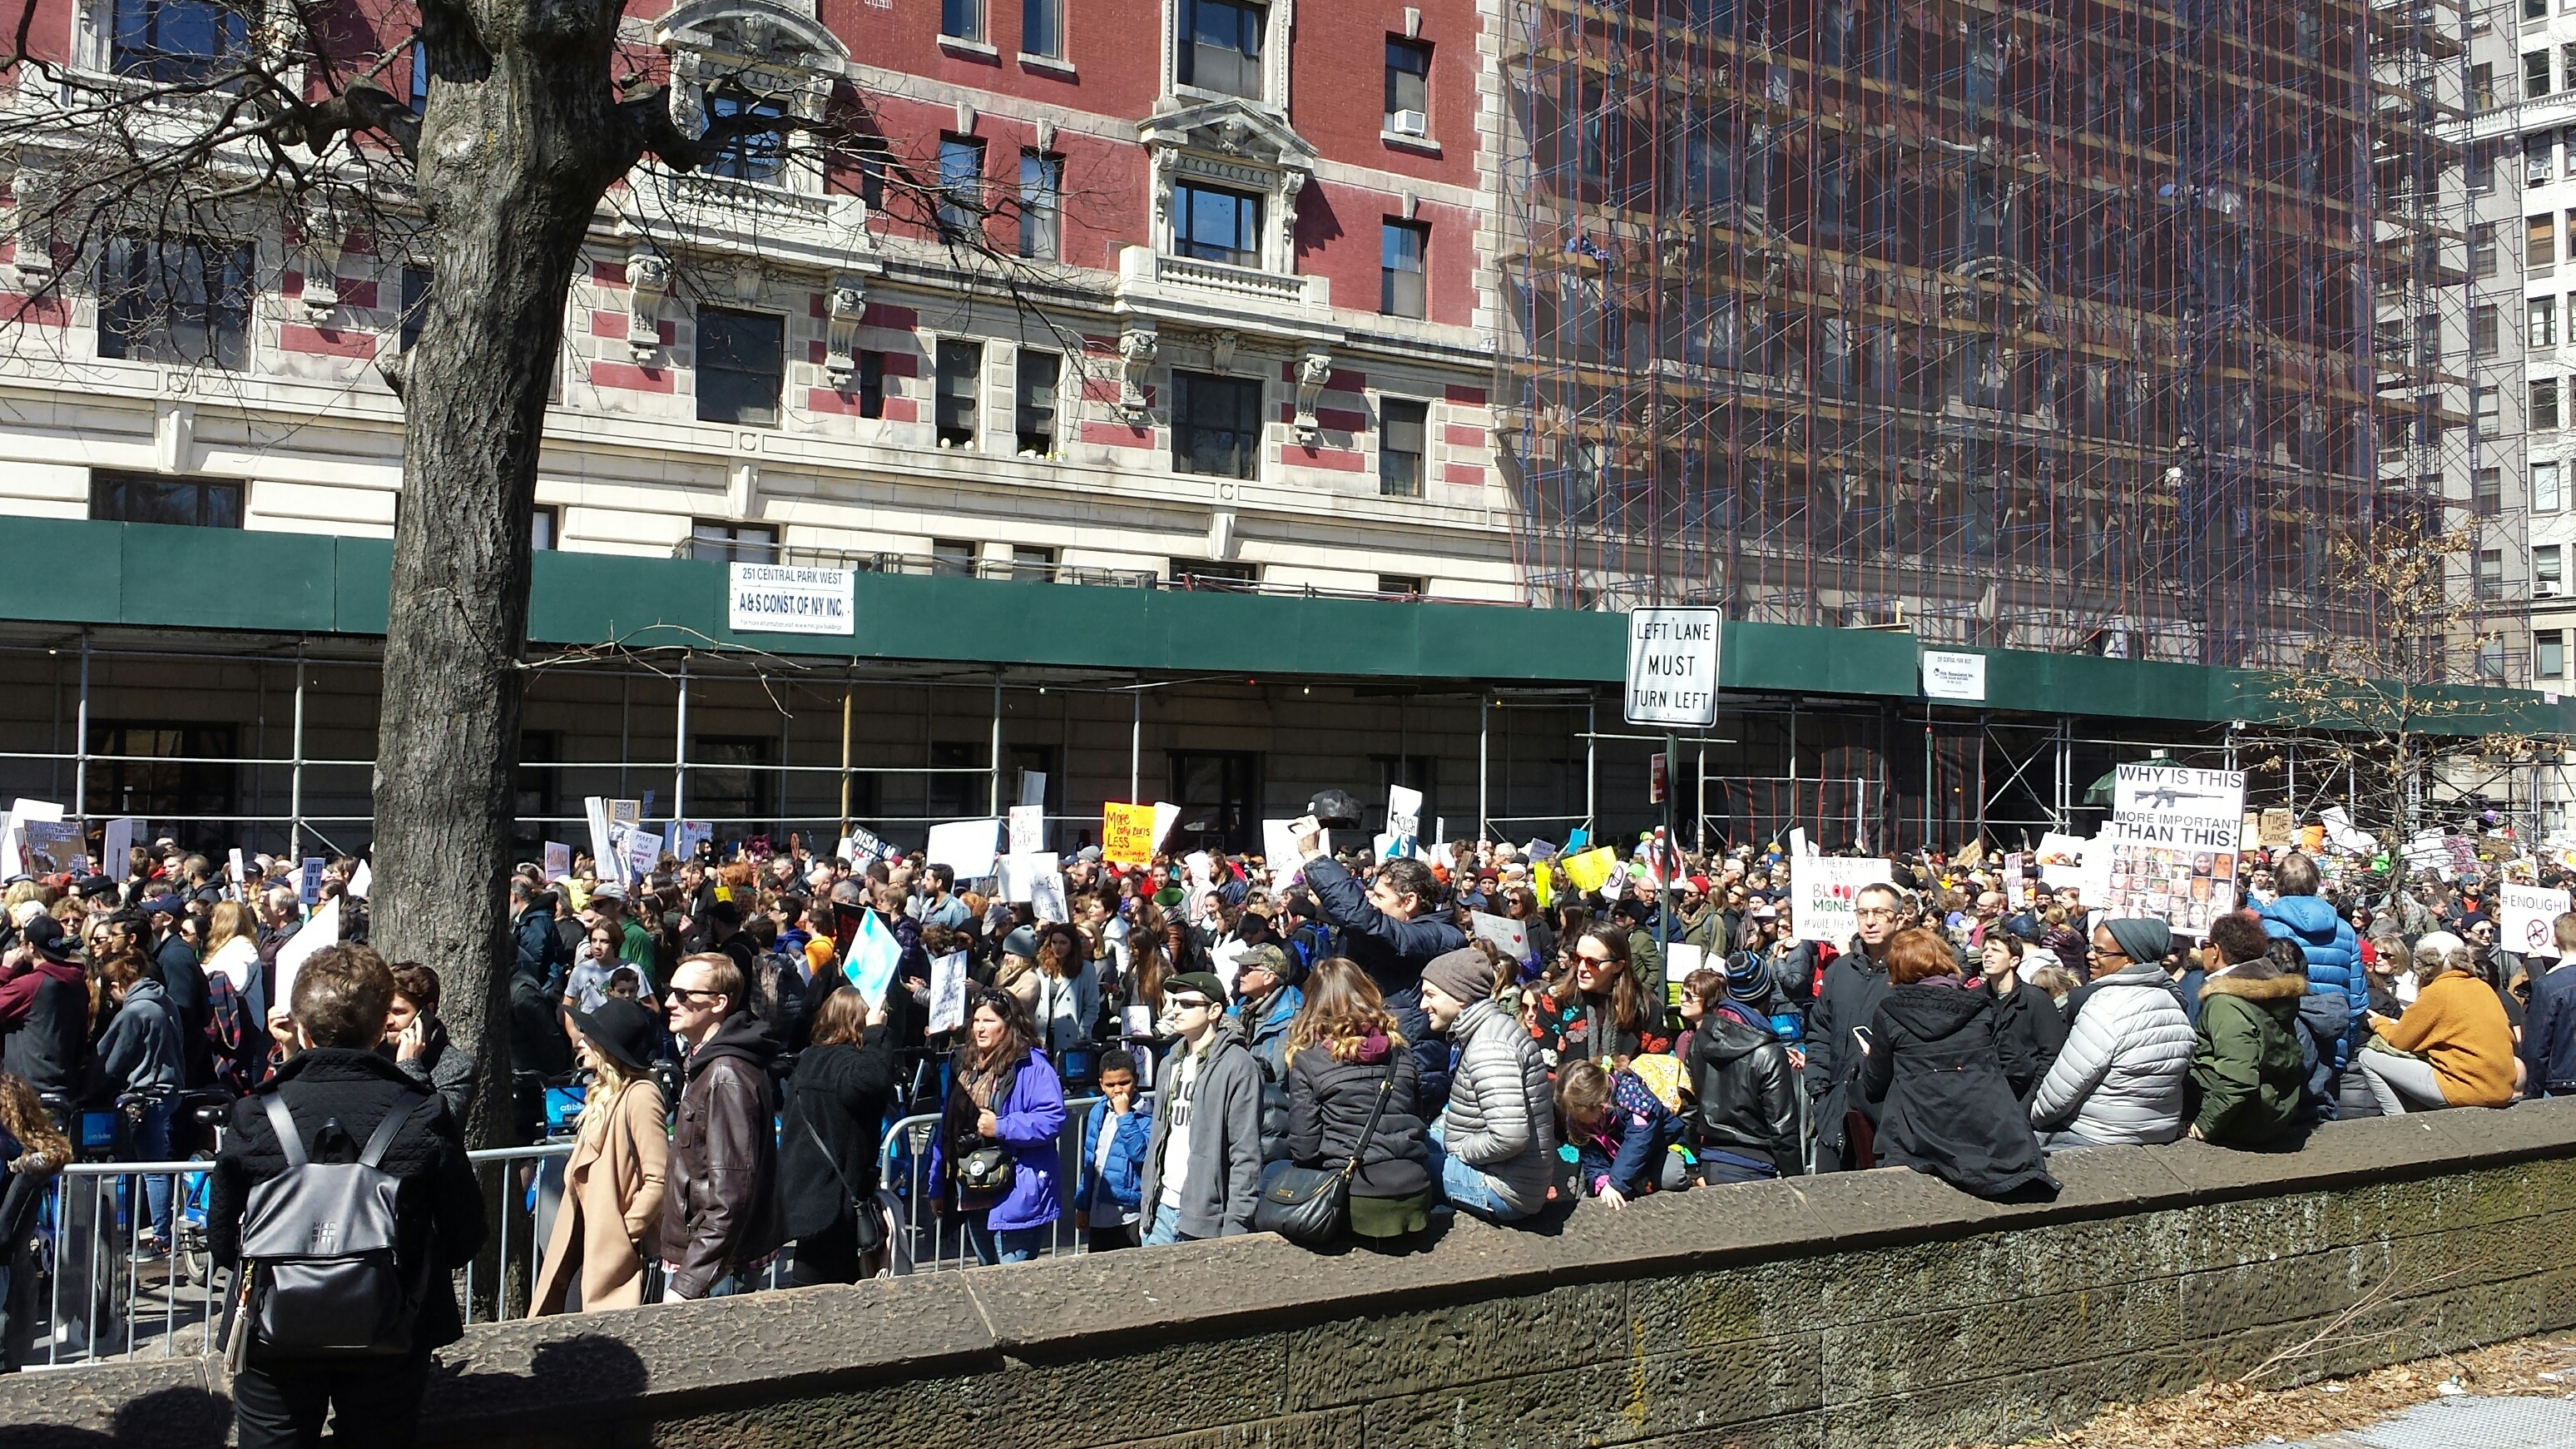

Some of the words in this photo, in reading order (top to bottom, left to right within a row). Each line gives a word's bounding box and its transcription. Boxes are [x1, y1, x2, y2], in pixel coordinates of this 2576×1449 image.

[742, 568, 755, 580] 251
[757, 568, 795, 582] CENTRAL
[797, 570, 817, 583] PARK
[820, 572, 842, 584] WEST
[797, 596, 809, 614] OF
[811, 597, 824, 616] NY
[827, 598, 844, 617] INC.
[1637, 623, 1669, 639] LEFT
[1676, 623, 1711, 641] LANE
[1647, 655, 1696, 676] MUST
[1634, 689, 1667, 707] TURN
[1676, 692, 1708, 710] LEFT
[2118, 766, 2165, 782] WHY
[2172, 769, 2188, 785] IS
[2197, 771, 2242, 788] THIS
[2115, 811, 2154, 823] MORE
[2159, 814, 2240, 831] IMPORTANT
[2265, 814, 2288, 825] TIME
[2115, 822, 2173, 842] THAN
[2181, 827, 2237, 847] THIS:
[852, 829, 895, 861] DISARM
[1807, 859, 1815, 867] IF
[1820, 858, 1842, 868] THEY
[2501, 894, 2567, 912] #ENOUGH!
